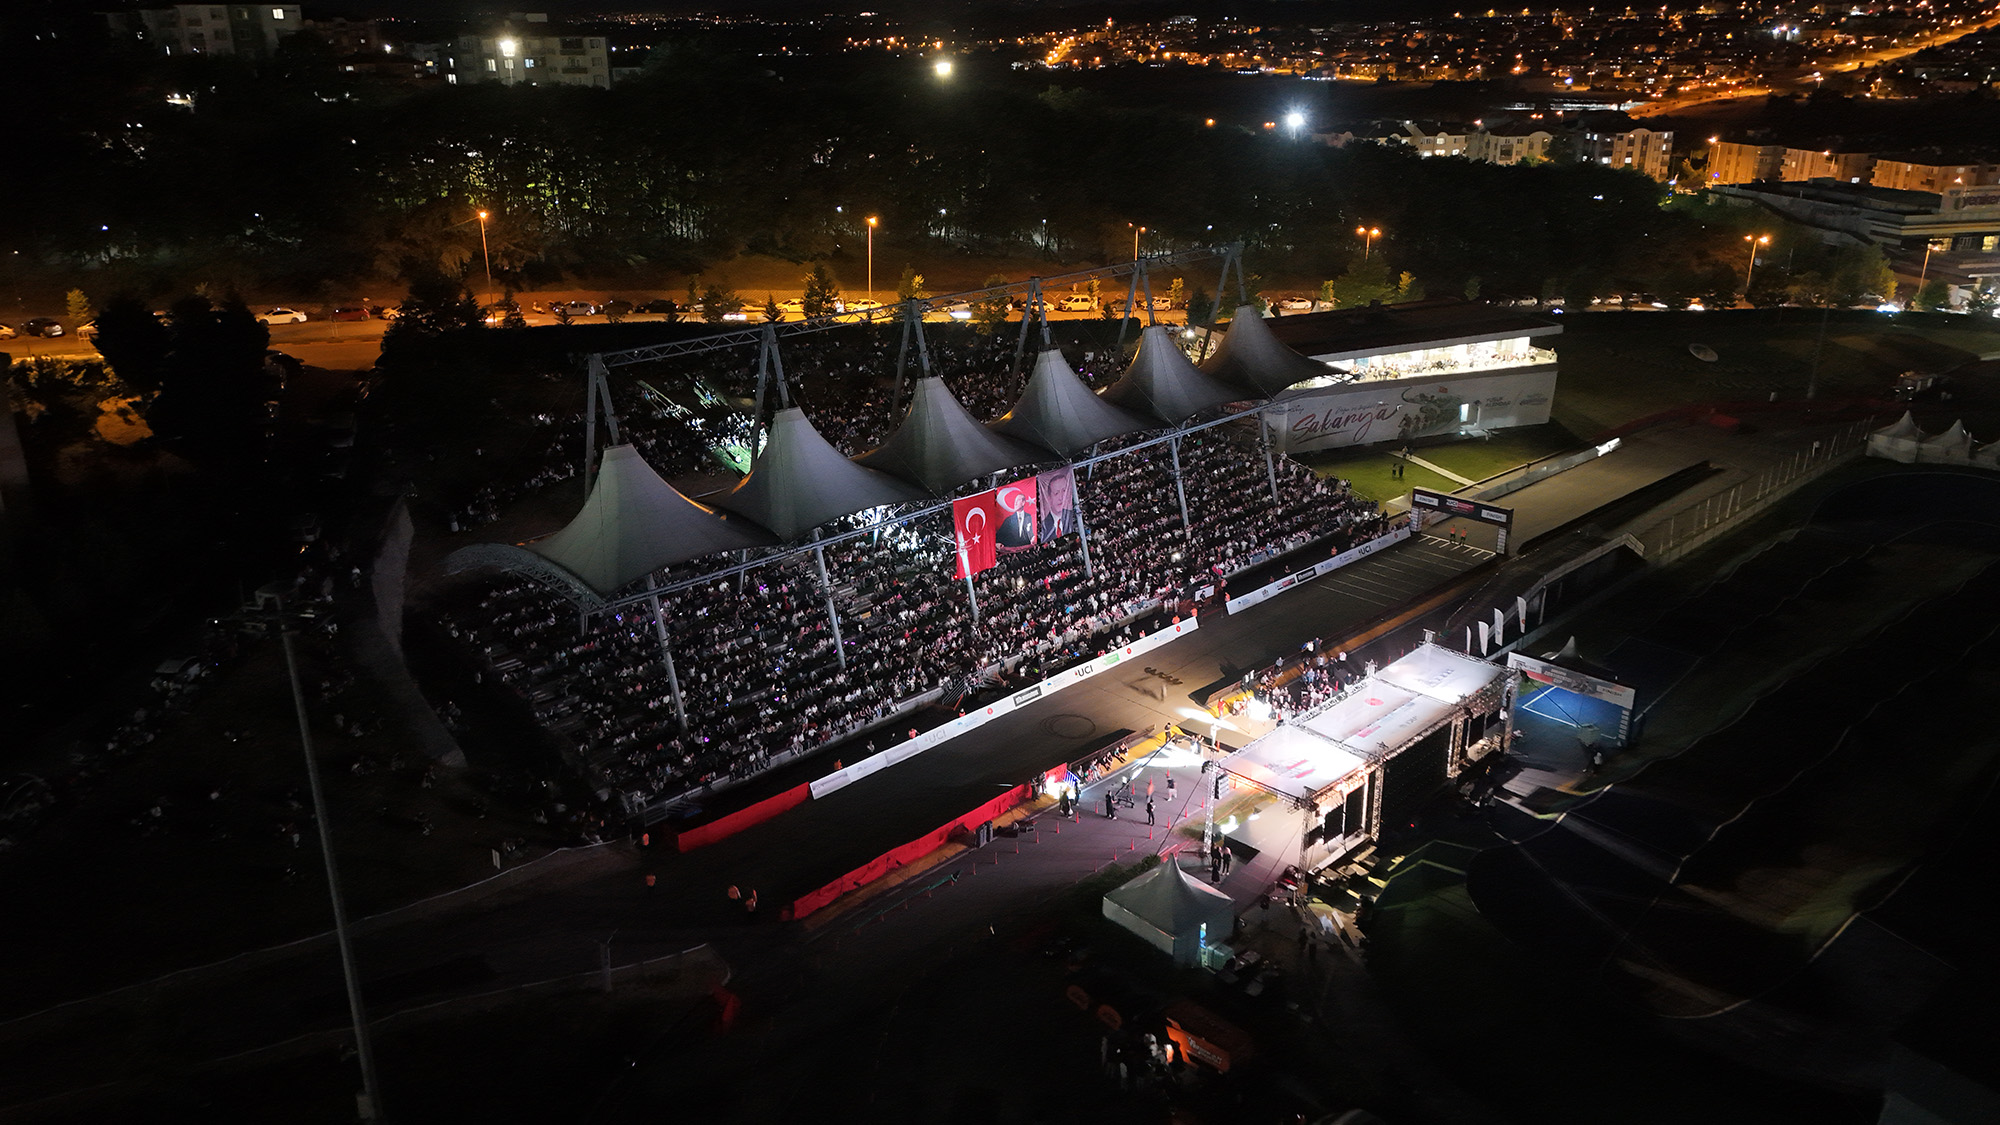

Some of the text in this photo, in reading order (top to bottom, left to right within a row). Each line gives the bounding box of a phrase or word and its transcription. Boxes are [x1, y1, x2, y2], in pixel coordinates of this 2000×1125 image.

[1292, 408, 1398, 443] Sakarya
[1361, 545, 1372, 555] UCI
[1077, 664, 1094, 677] UCI
[929, 731, 947, 744] UCI
